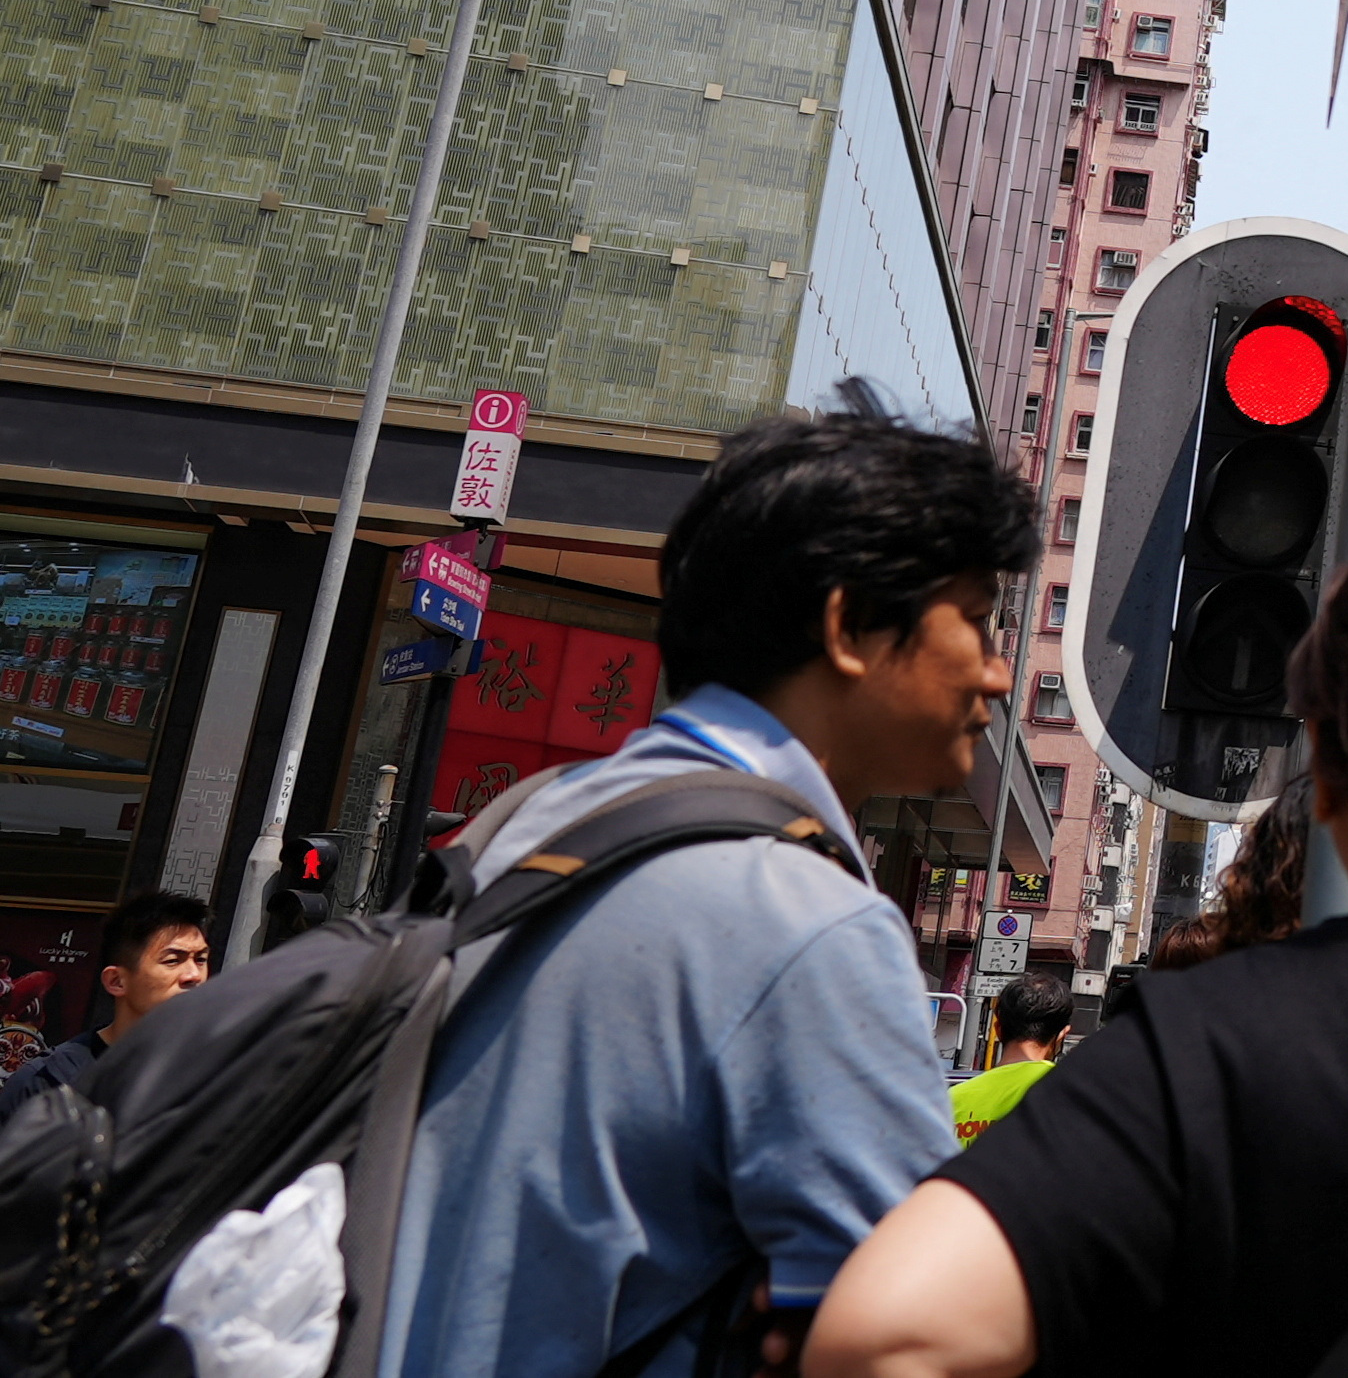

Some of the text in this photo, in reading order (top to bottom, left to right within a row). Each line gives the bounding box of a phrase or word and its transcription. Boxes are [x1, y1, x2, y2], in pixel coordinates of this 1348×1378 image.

[458, 440, 502, 510] 佐敦
[1011, 942, 1019, 953] 7
[1009, 959, 1017, 971] 7
